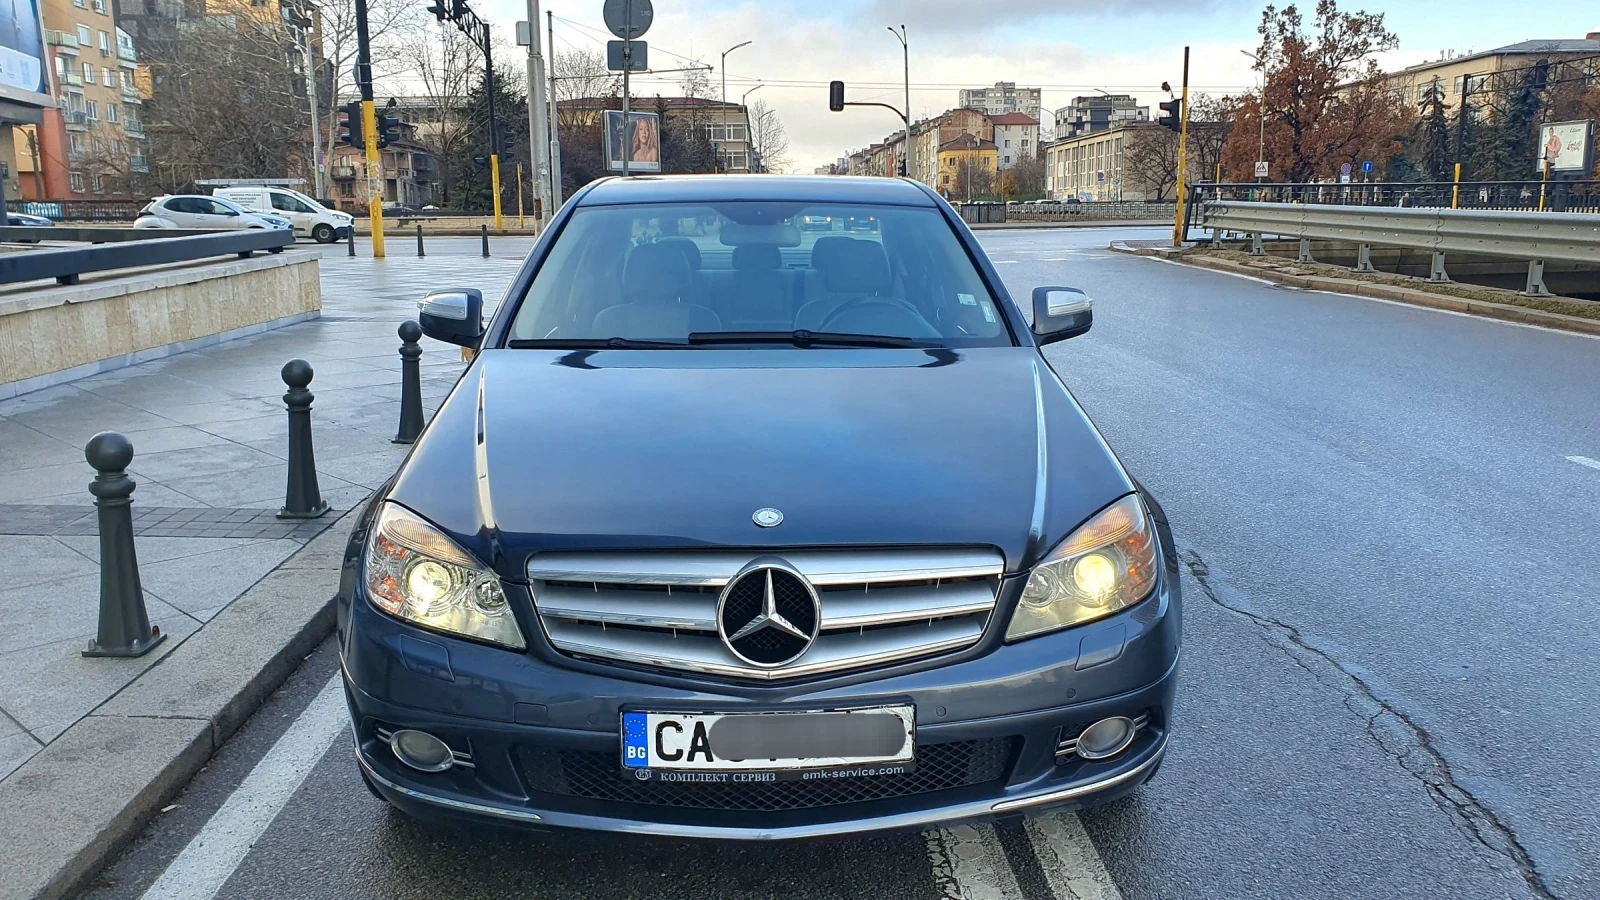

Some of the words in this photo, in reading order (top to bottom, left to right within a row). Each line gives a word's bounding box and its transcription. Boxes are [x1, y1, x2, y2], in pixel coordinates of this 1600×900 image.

[627, 745, 646, 759] BG
[660, 773, 728, 782] КОМПЛЕКТ
[733, 773, 776, 782] СЕРВИЗ
[802, 766, 904, 780] emk-service.com
